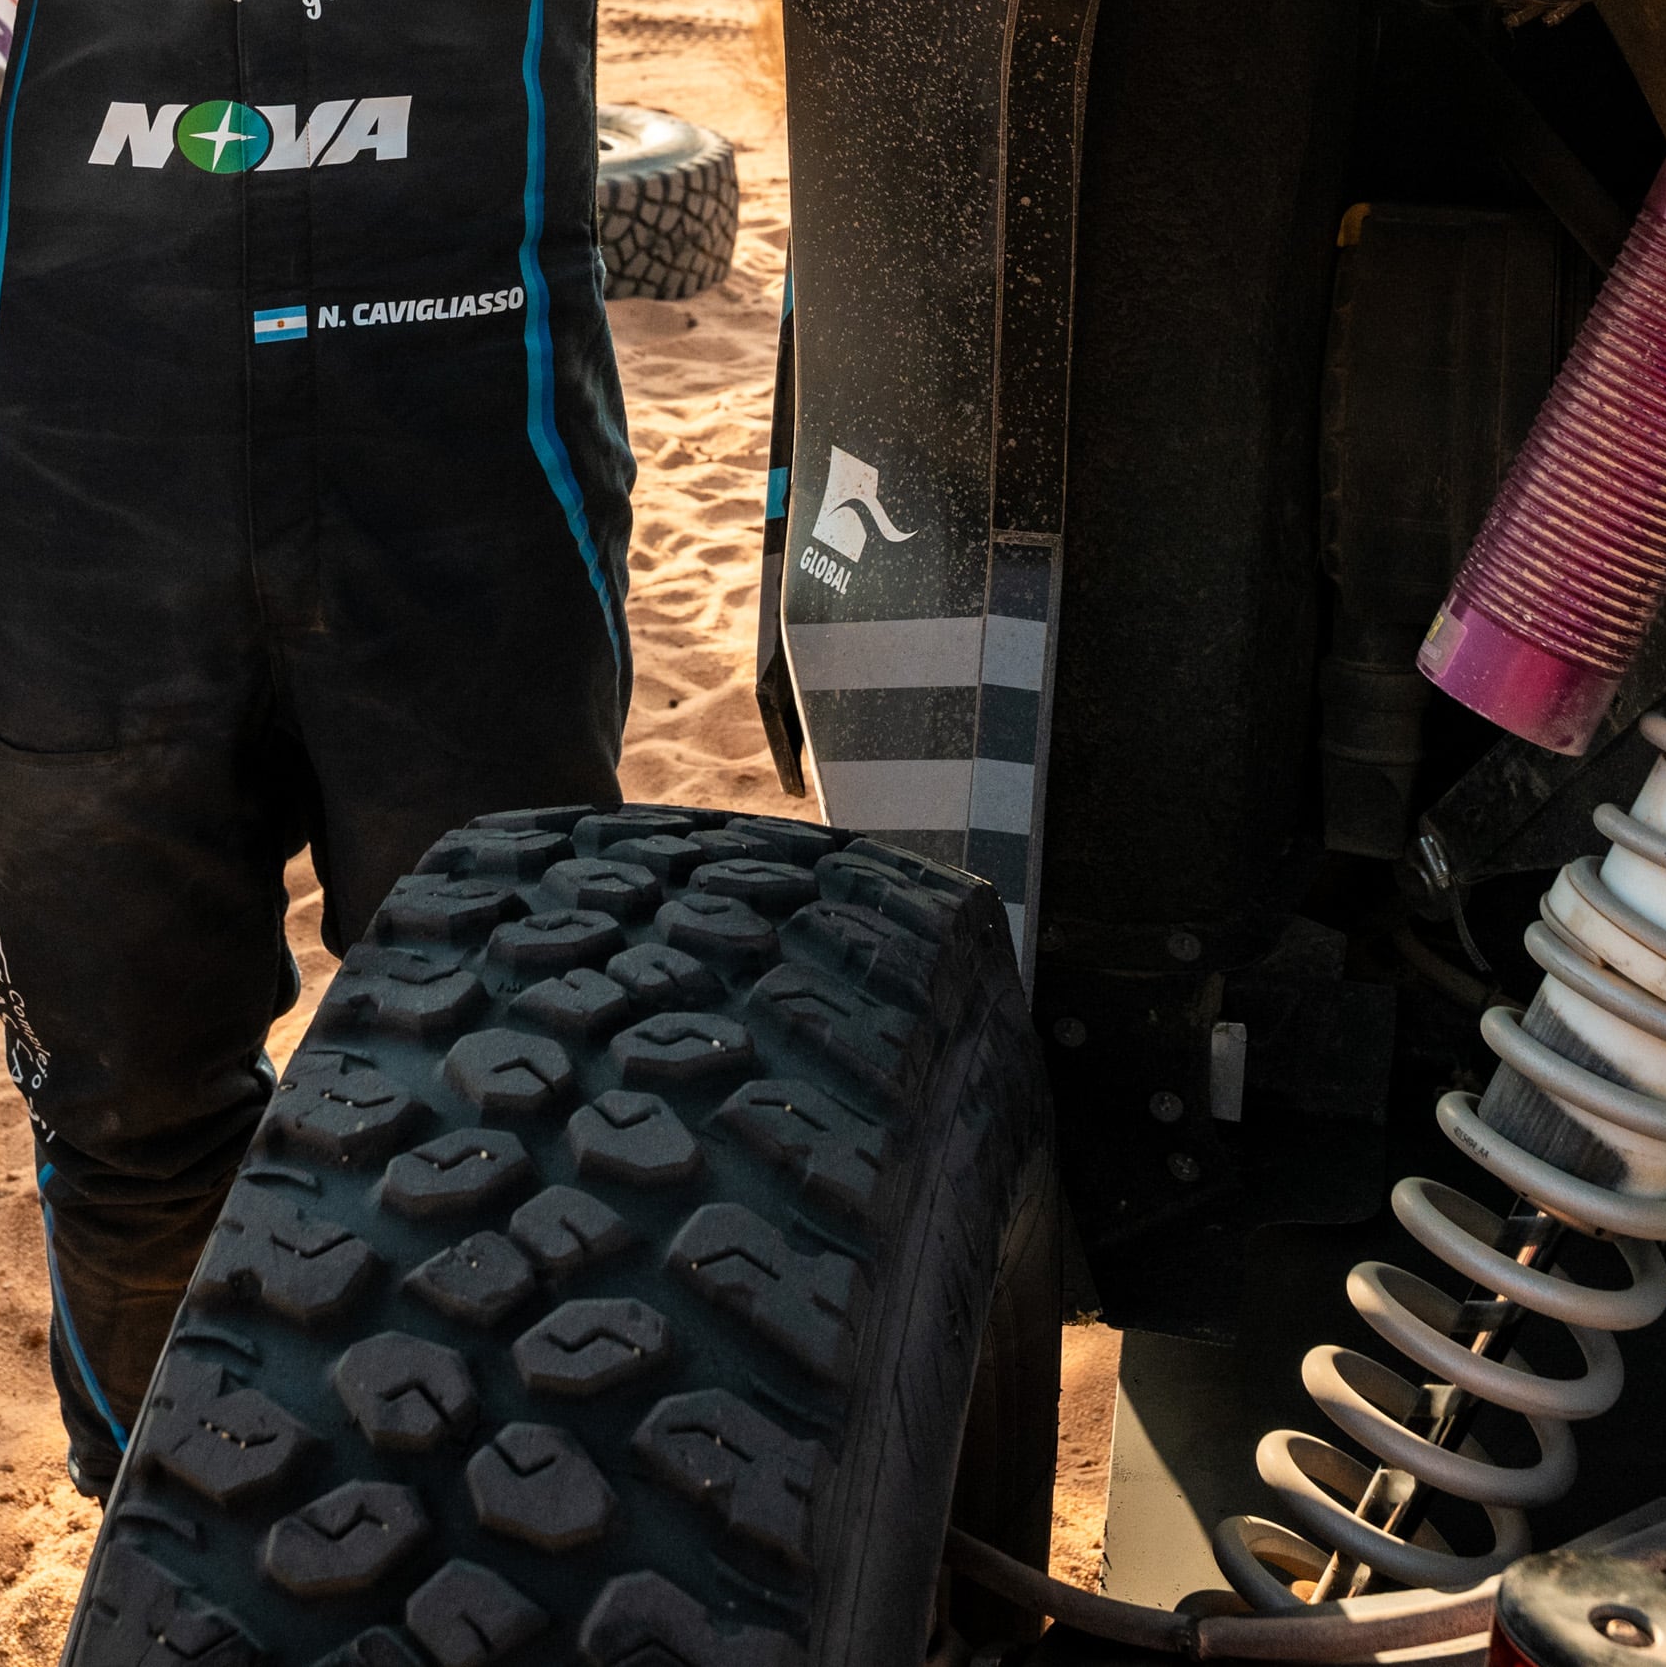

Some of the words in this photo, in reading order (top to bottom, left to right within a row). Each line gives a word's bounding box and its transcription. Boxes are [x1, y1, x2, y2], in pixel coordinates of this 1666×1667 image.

[88, 95, 413, 174] NOVA
[318, 305, 346, 329] N.
[352, 286, 525, 325] CAVIGLIASSO
[799, 545, 853, 596] GLOBAL
